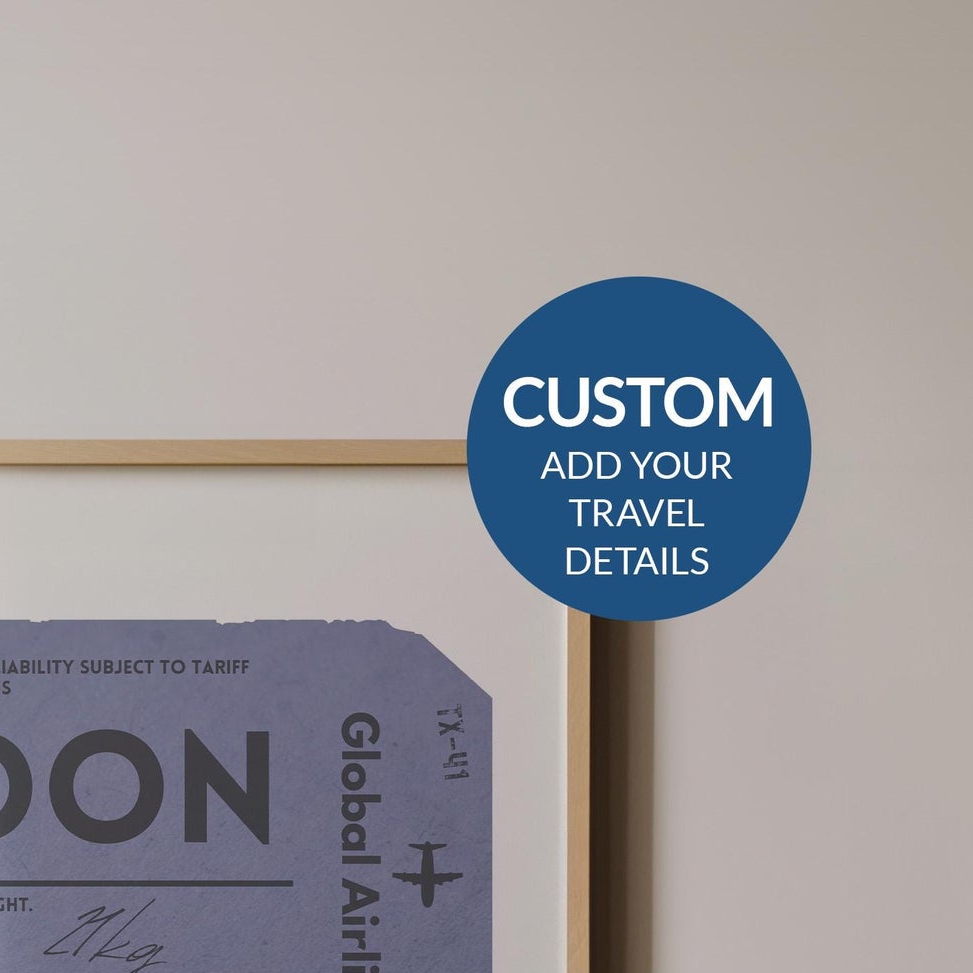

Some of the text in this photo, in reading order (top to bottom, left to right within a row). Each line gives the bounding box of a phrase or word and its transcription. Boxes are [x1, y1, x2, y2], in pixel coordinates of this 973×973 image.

[80, 659, 155, 675] SUBJECT
[159, 659, 186, 675] TO
[191, 659, 250, 675] TARIFF
[436, 703, 470, 781] TX-41
[340, 711, 382, 865] Global
